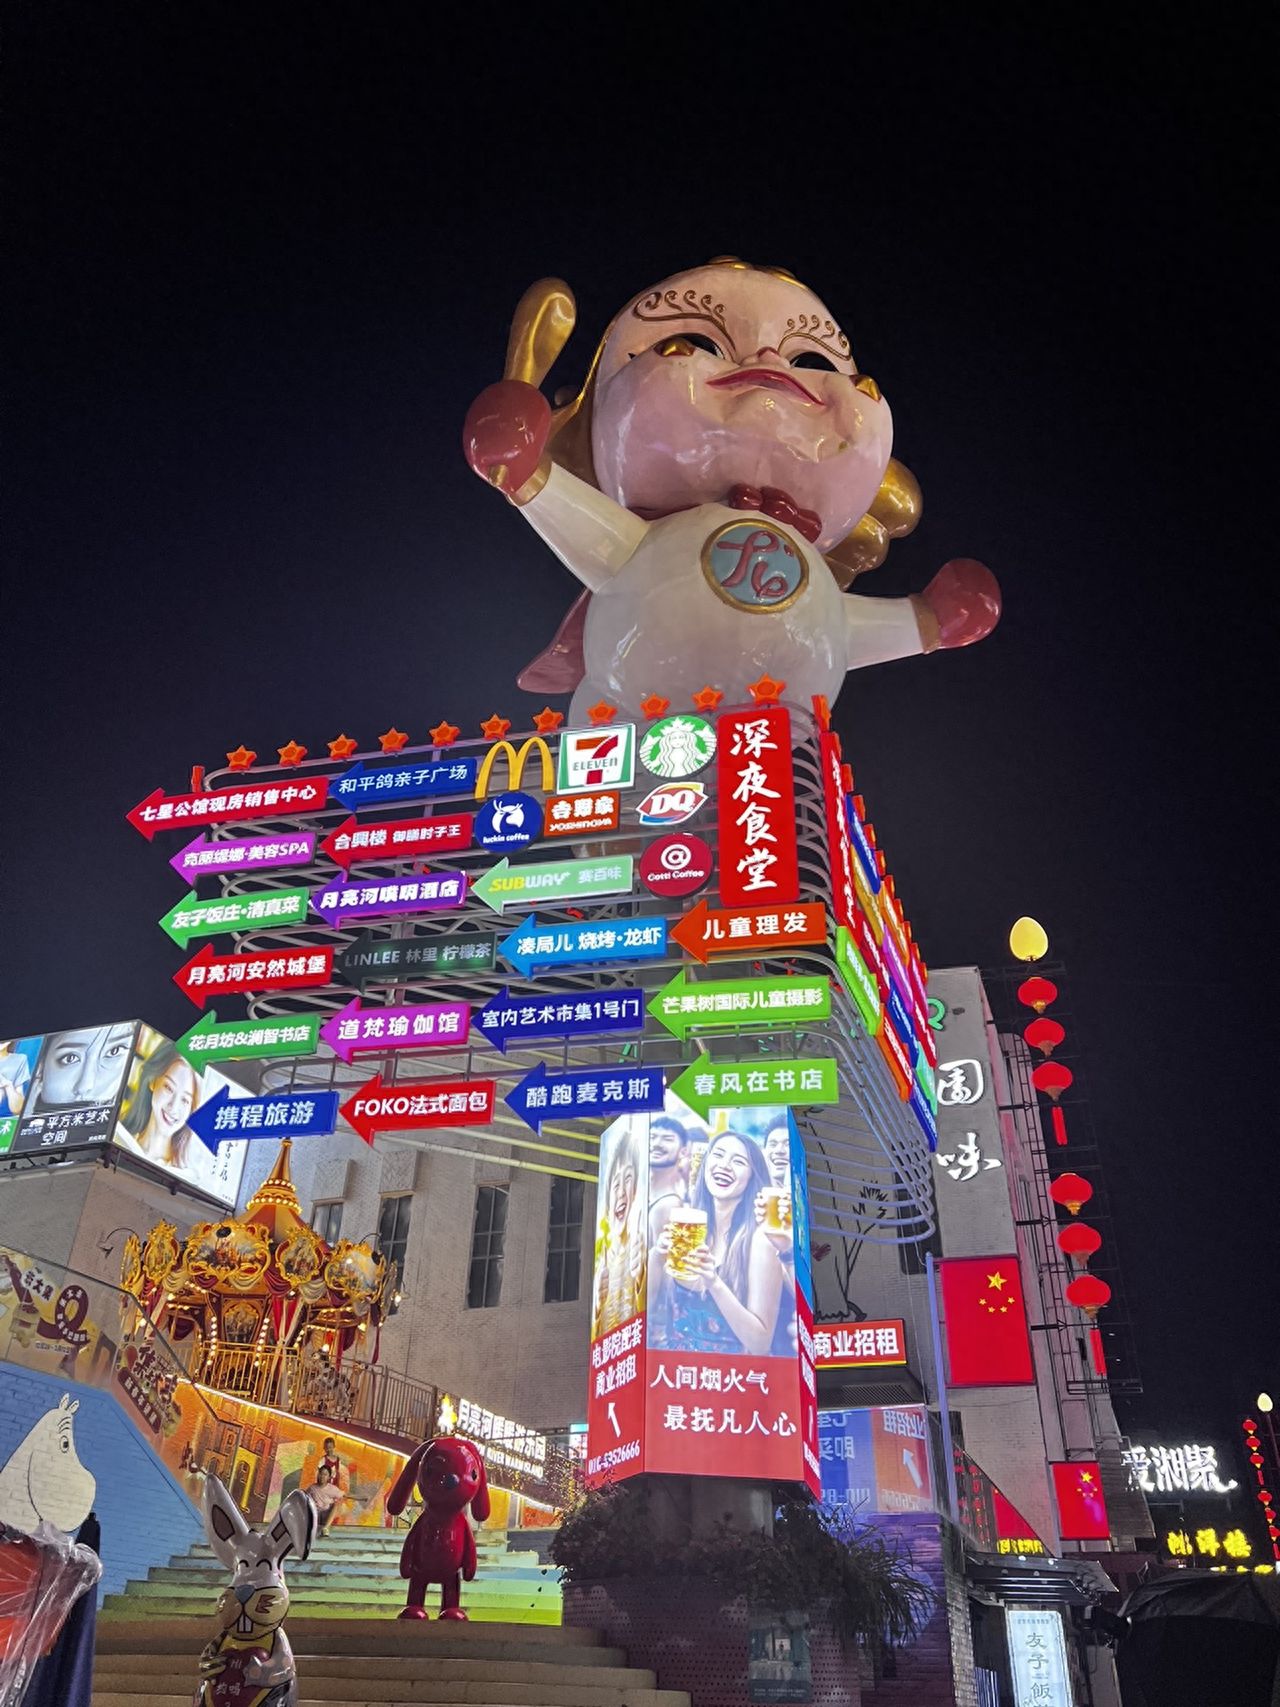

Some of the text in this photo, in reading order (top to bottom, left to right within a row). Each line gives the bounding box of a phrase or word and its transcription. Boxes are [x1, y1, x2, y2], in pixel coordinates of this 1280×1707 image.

[339, 765, 467, 794] 和平鸽亲子广场
[139, 785, 317, 821] 七星公馆现房销售中心
[551, 796, 614, 820] 吉野家
[649, 790, 695, 815] DQ
[730, 719, 781, 891] 深夜食堂
[483, 832, 529, 844] luckin coffee
[488, 872, 570, 892] SUBWAY
[672, 869, 704, 880] Coffee
[171, 895, 301, 929] 友子饭庄·清真菜
[702, 912, 808, 940] 儿童理发
[345, 943, 491, 967] LINLEE 林里 柠檬茶
[187, 955, 326, 985] 月亮河安然城堡
[482, 1000, 639, 1028] 室内艺术市集1号门
[662, 988, 823, 1014] 芒果树国际儿童摄影
[338, 1012, 460, 1040] 道梵瑜伽馆
[526, 1078, 650, 1108] 酷跑麦克斯
[694, 1069, 822, 1095] 春风在书店
[214, 1101, 315, 1130] 携程旅游
[353, 1091, 487, 1117] FOKO法式面包
[41, 1130, 68, 1146] 空间
[592, 1318, 643, 1368] 电影院配套
[812, 1328, 899, 1358] 商业招租
[595, 1354, 637, 1399] 商业招租
[650, 1364, 769, 1395] 人间烟火气
[663, 1404, 797, 1436] 最抚凡人心
